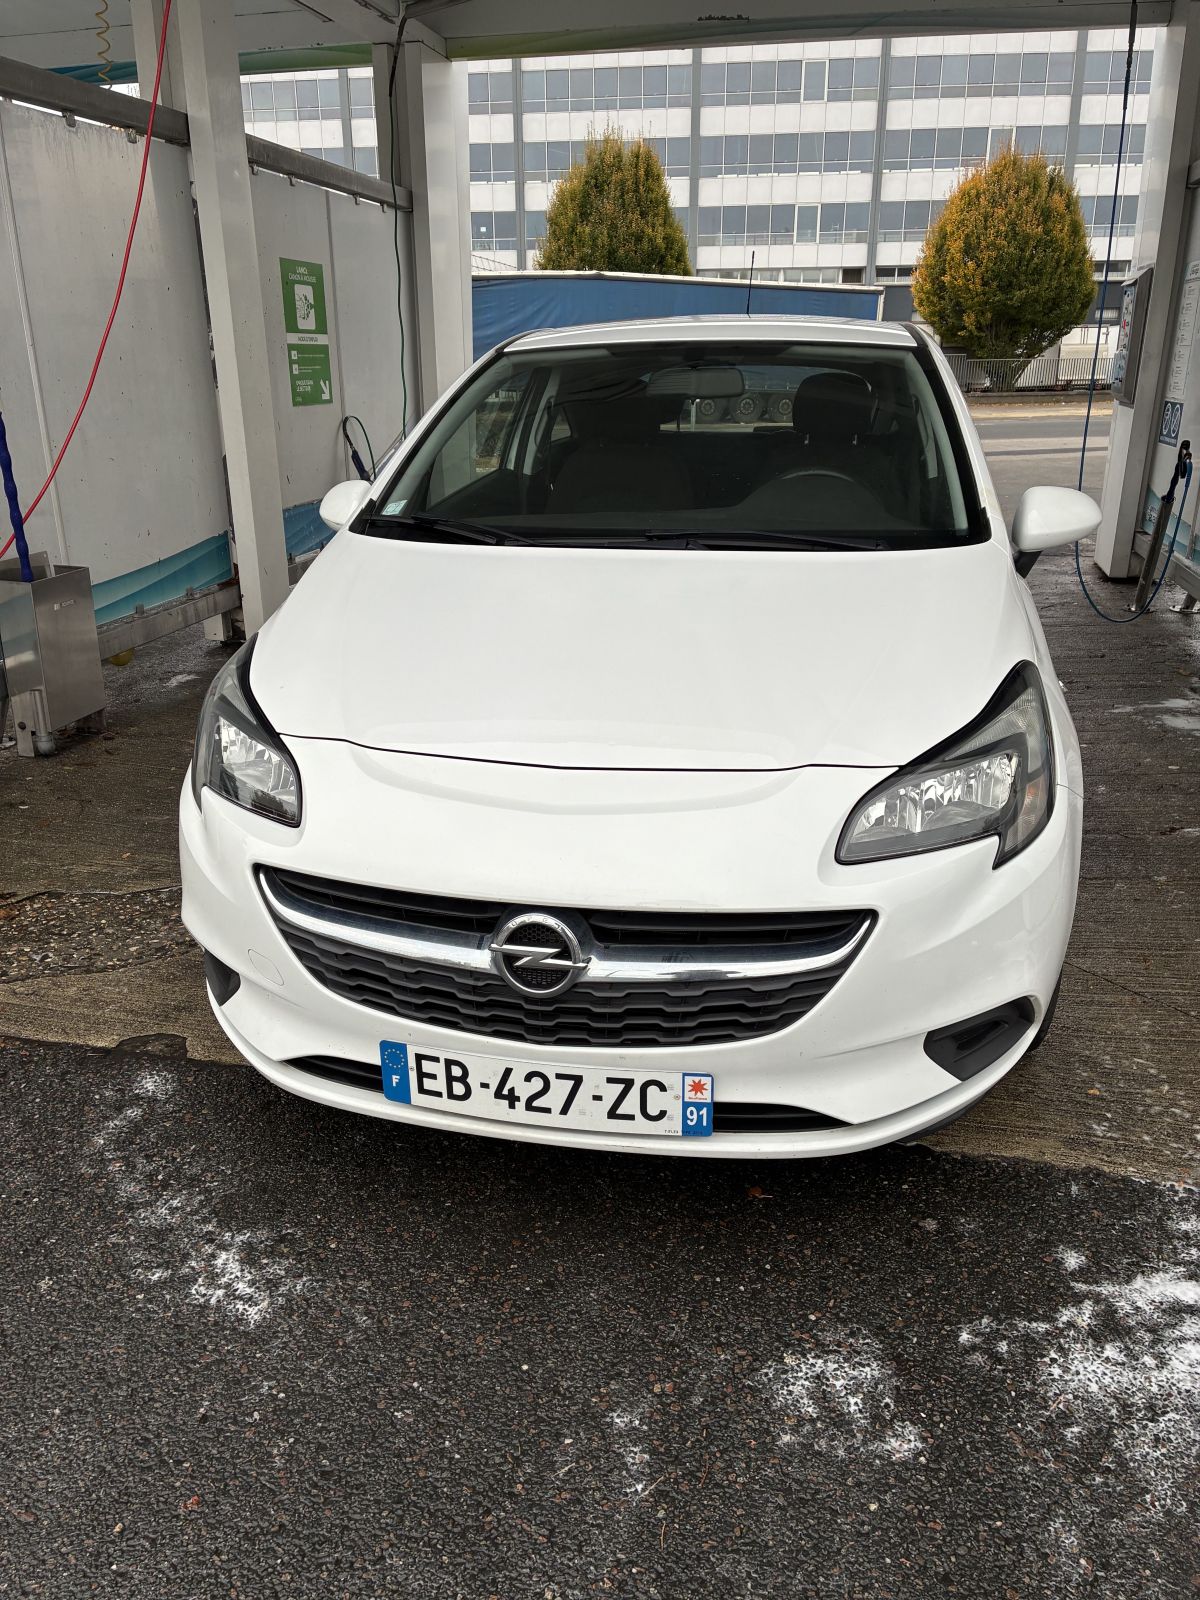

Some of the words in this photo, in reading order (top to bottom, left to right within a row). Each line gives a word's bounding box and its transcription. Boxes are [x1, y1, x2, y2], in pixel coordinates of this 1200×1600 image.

[391, 1074, 400, 1087] F
[415, 1053, 667, 1122] EB-427-ZC
[686, 1106, 708, 1127] 91
